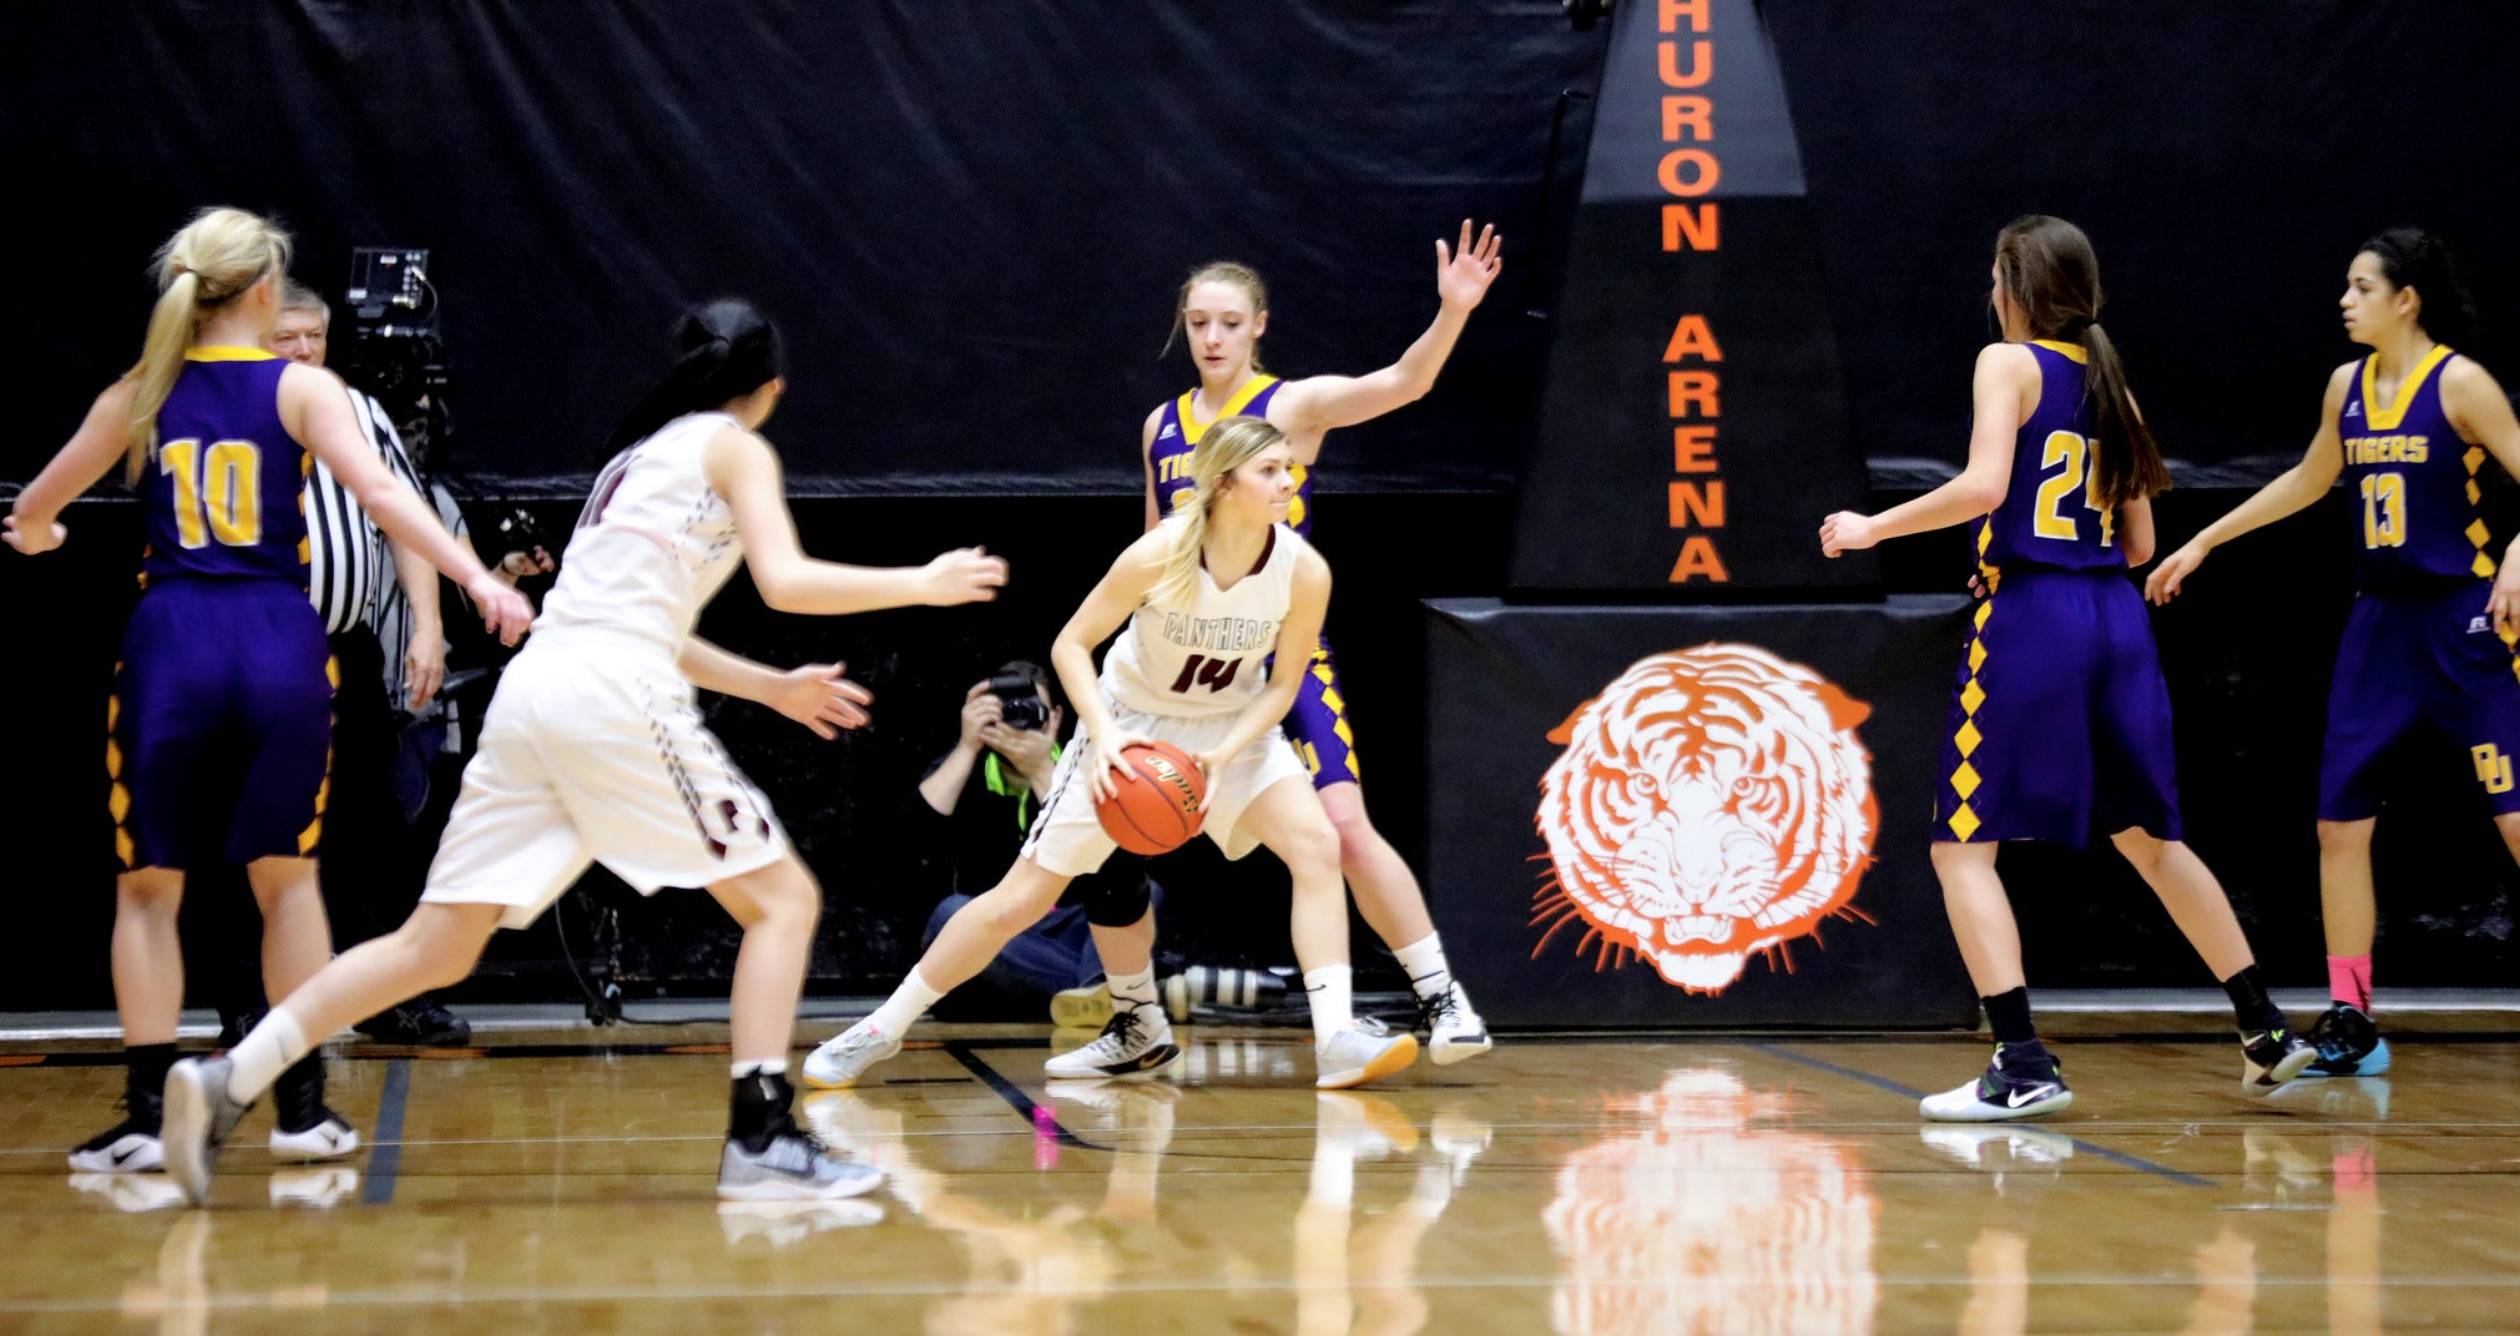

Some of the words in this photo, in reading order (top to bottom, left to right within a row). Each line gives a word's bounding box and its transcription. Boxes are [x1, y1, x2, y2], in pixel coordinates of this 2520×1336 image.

[1657, 0, 1721, 252] HURON
[1662, 314, 1731, 584] ARENA
[2344, 436, 2429, 465] TIGERS
[159, 438, 262, 549] 10
[2360, 472, 2407, 549] 13
[1163, 612, 1272, 651] PANTHERS
[1170, 654, 1243, 694] 14
